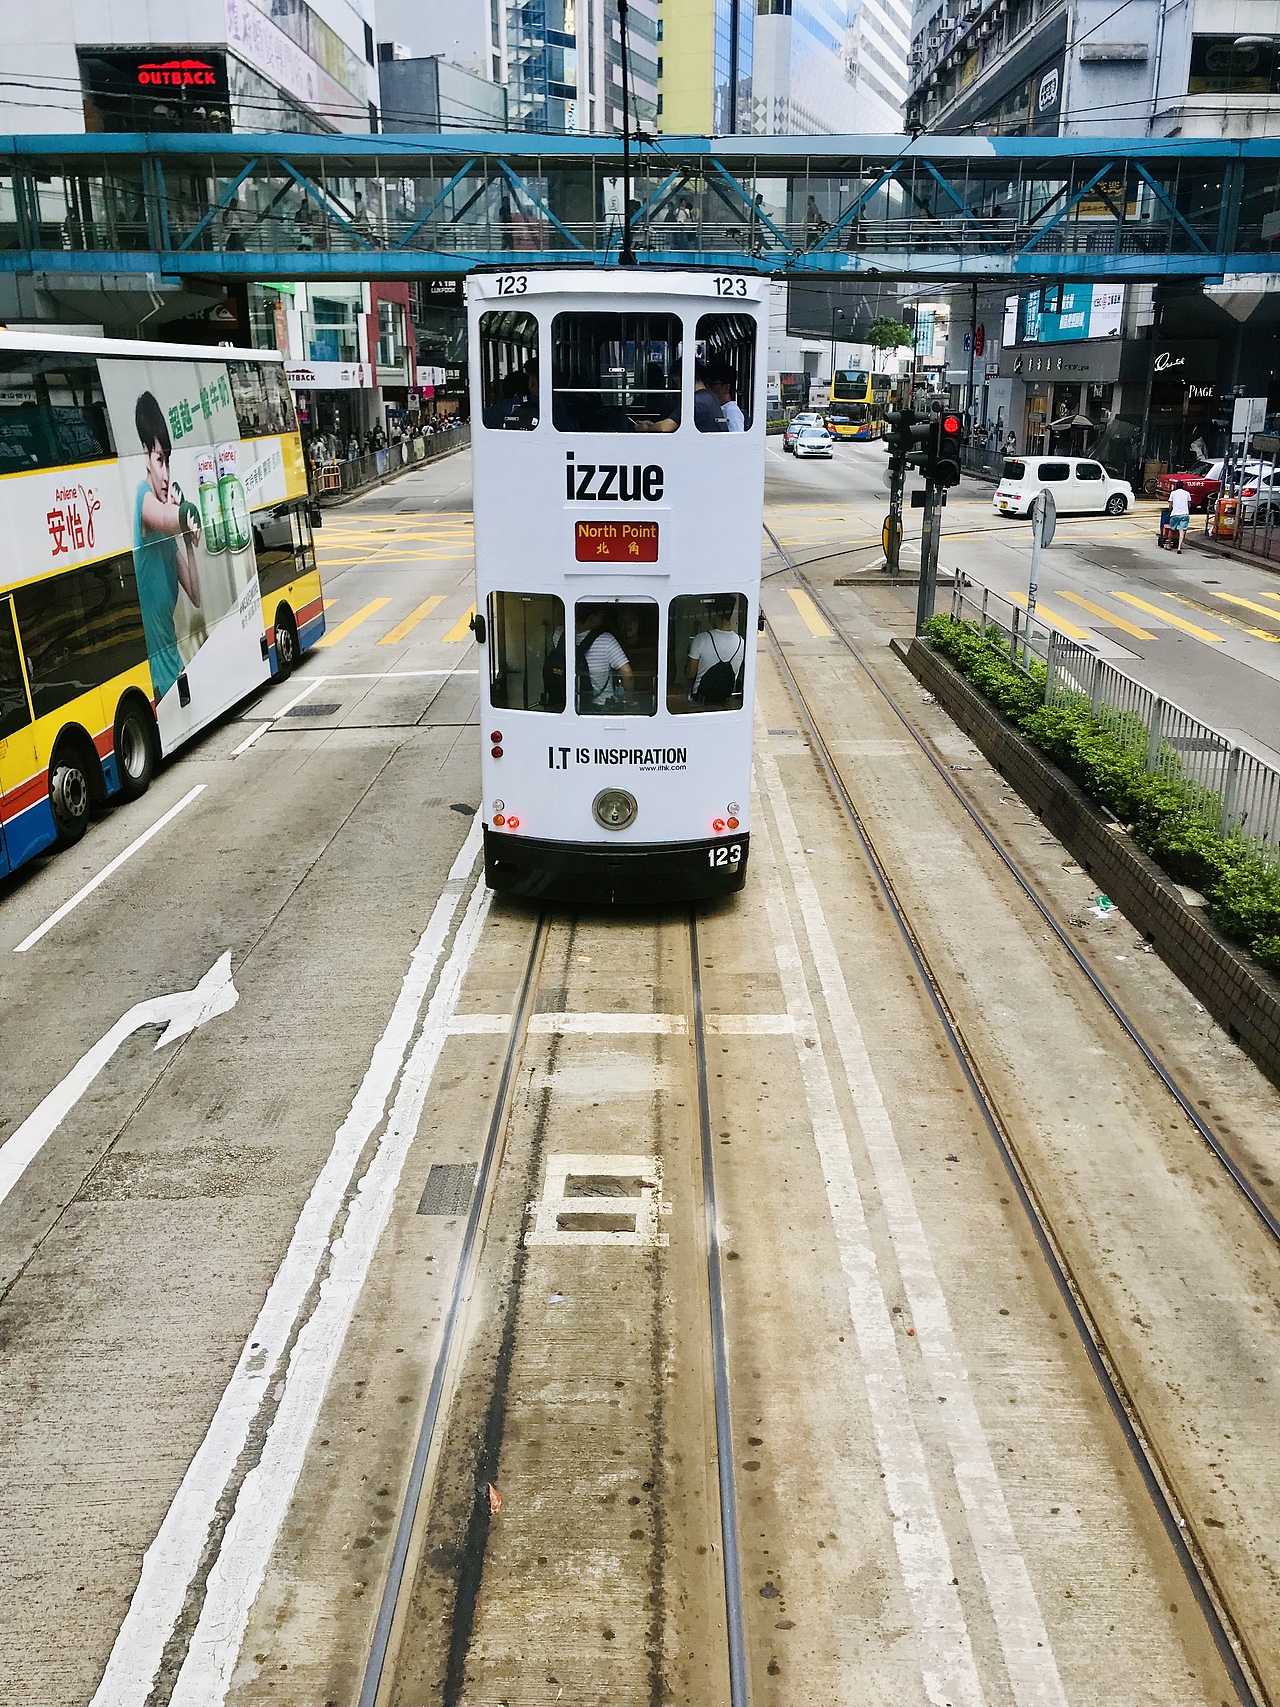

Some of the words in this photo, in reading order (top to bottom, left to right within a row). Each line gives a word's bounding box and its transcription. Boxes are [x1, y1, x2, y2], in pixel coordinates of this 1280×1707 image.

[138, 71, 216, 85] OUTBACK
[495, 275, 528, 295] 123
[712, 277, 747, 296] 123
[1188, 384, 1216, 399] PIAGE
[566, 451, 664, 501] izzue
[47, 503, 85, 556] 安怡
[578, 524, 617, 538] North
[622, 524, 656, 538] Point
[576, 747, 590, 764] IS
[594, 747, 687, 764] INSPIRATION
[708, 844, 741, 867] 123
